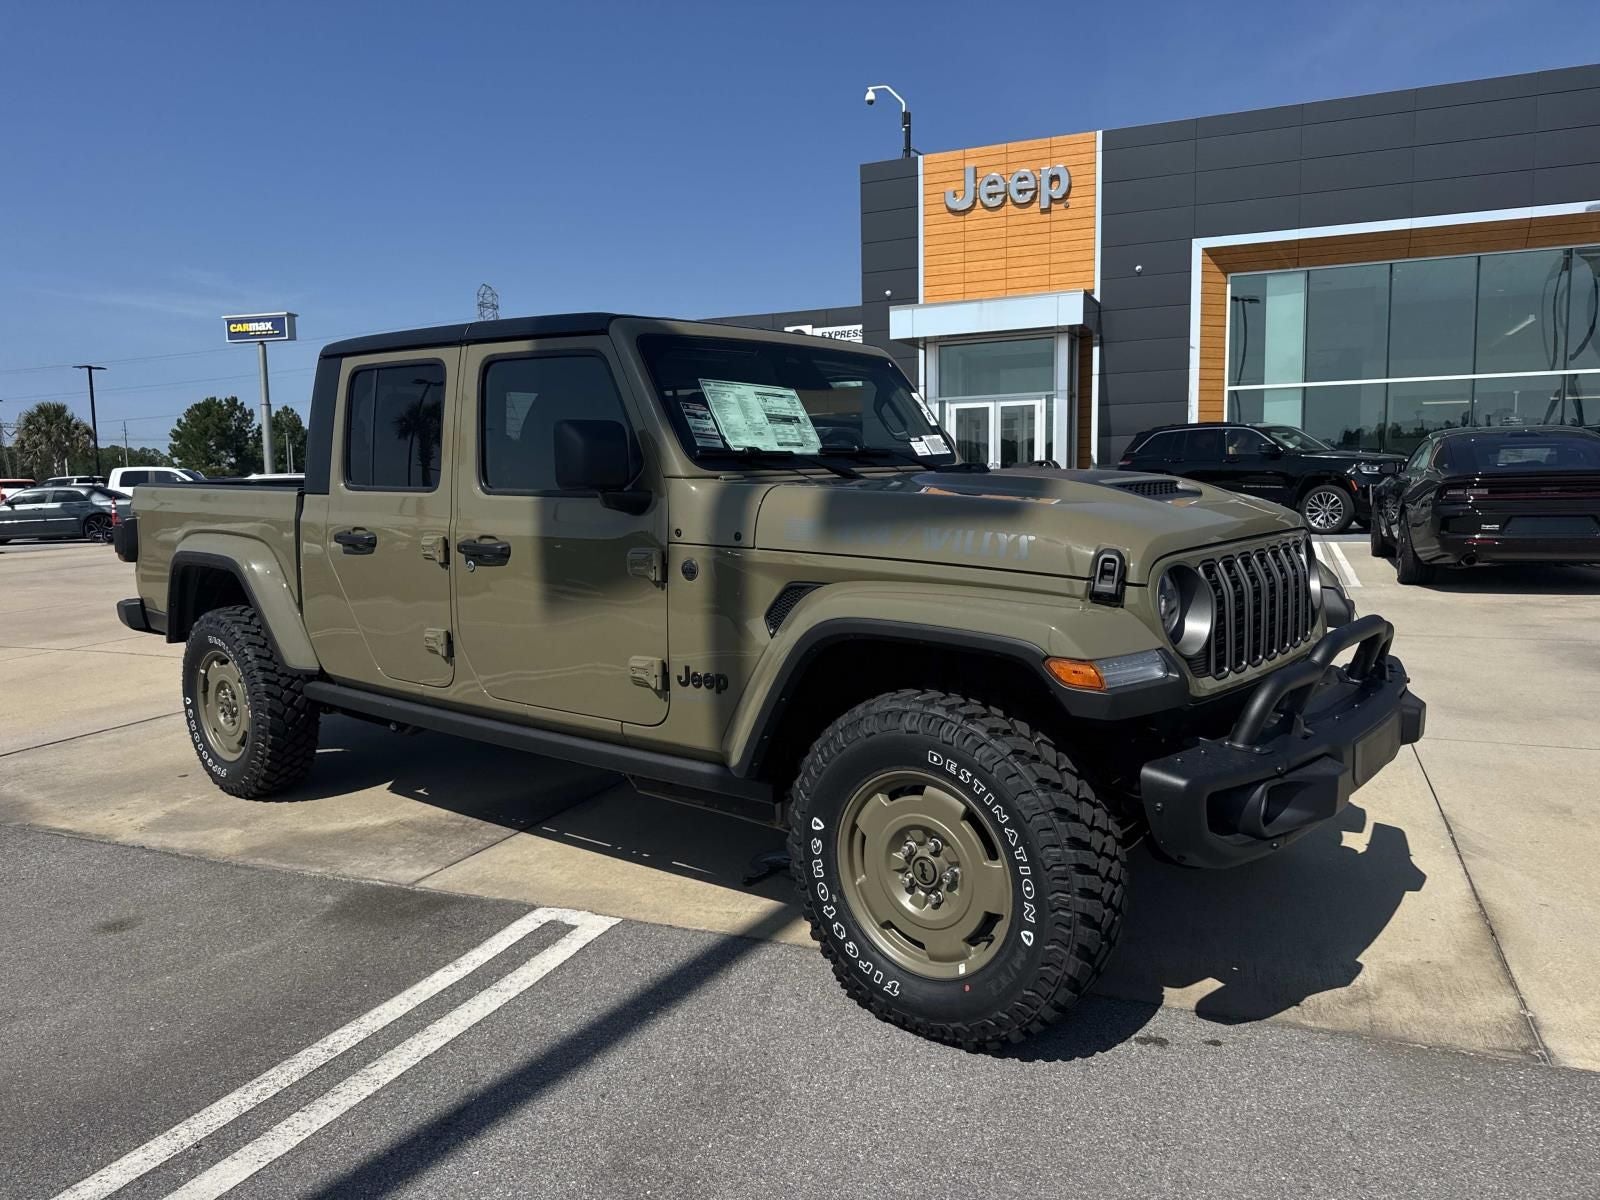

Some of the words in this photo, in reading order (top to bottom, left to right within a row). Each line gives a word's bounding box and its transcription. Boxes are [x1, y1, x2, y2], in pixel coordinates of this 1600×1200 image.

[944, 164, 1072, 213] Jeep
[676, 665, 729, 695] Jeep
[927, 749, 1039, 925] DESTINATION
